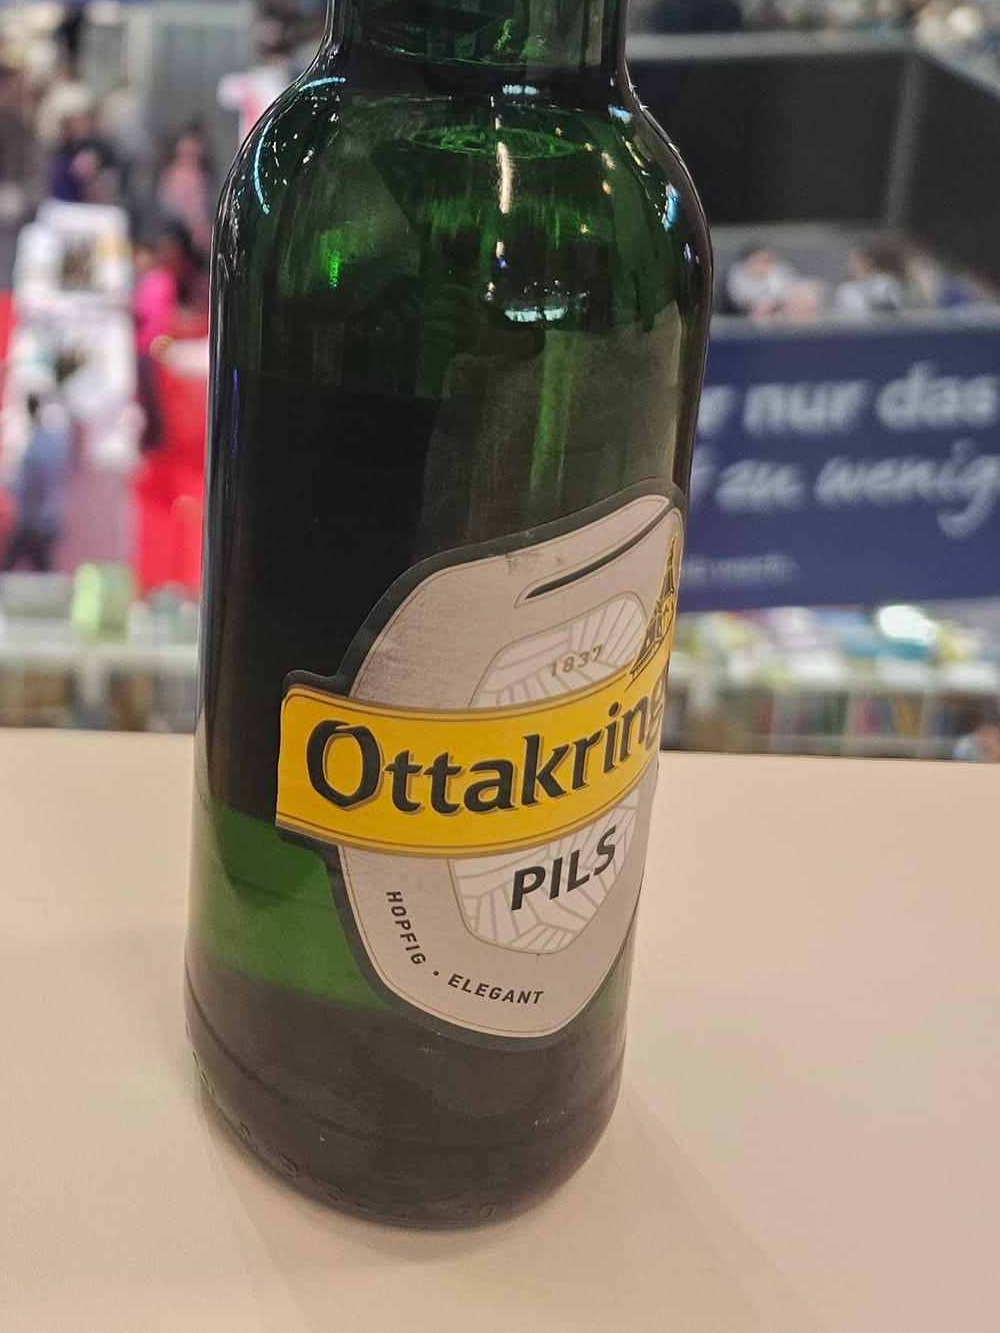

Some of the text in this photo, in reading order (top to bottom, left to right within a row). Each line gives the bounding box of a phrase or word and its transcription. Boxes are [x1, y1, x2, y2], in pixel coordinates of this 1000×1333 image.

[743, 380, 867, 437] nur
[876, 362, 998, 430] das
[715, 459, 804, 511] zu
[814, 438, 1000, 539] wenig
[548, 644, 605, 677] 1837
[511, 825, 617, 911] PILS
[386, 891, 545, 1005] HOPFIG ELEGANT
